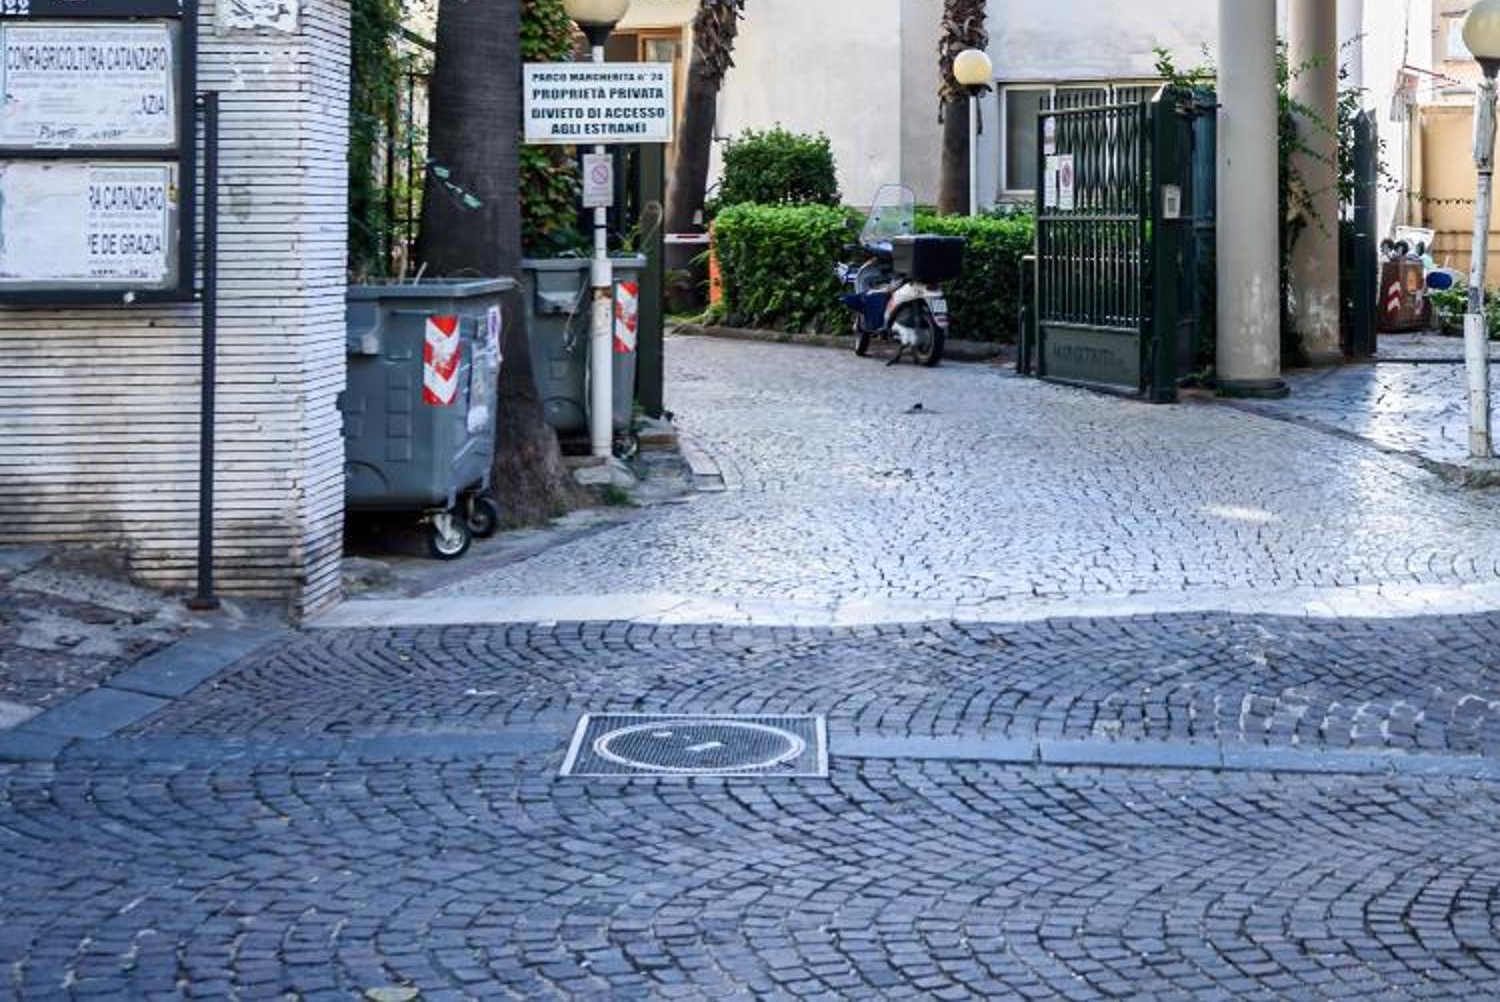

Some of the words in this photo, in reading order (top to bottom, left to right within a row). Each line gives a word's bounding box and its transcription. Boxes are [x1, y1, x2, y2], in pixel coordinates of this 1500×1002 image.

[7, 45, 105, 71] CONFAGRICOLTURA
[106, 46, 166, 72] CATANZARO
[532, 73, 567, 82] PARCO
[569, 73, 635, 81] MARGHERITA
[609, 87, 664, 99] PRIVATA
[531, 107, 584, 119] DIVIETO
[587, 107, 600, 119] DI
[605, 107, 665, 119] ACCESSO
[551, 123, 581, 135] AGLI
[584, 122, 647, 135] ESTRANEI
[103, 186, 164, 211] CATANZARO
[101, 233, 117, 255] DE
[119, 234, 162, 256] GRAZIA
